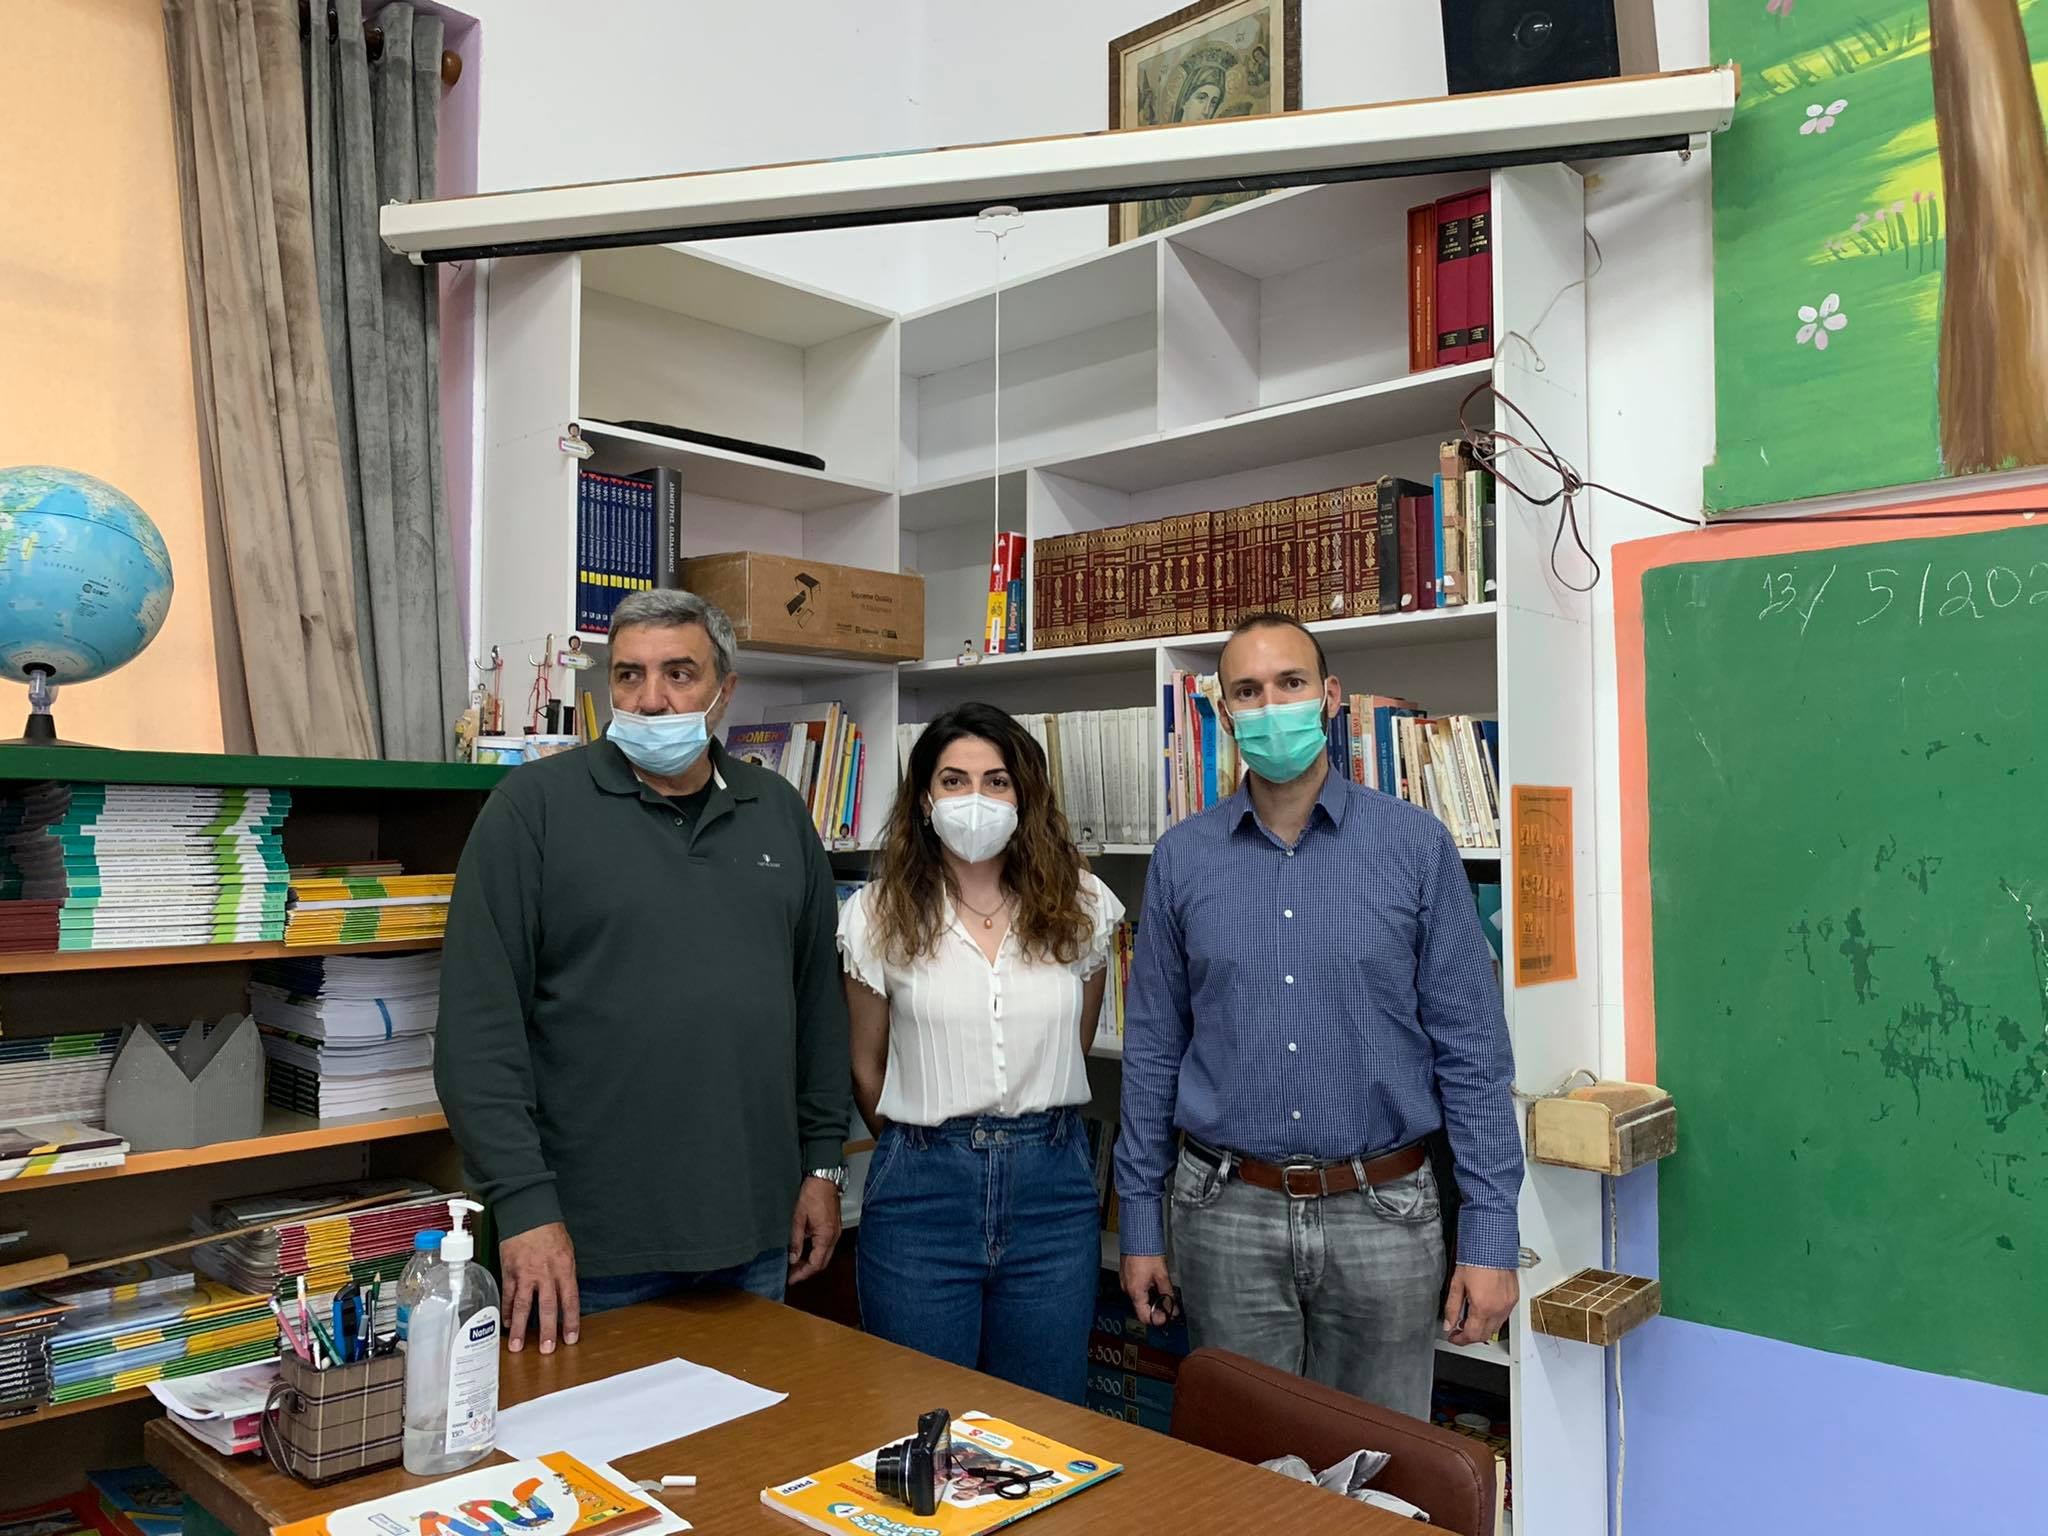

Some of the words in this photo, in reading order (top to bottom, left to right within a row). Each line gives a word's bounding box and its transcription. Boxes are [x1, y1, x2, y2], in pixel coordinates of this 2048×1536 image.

[1097, 1315, 1122, 1336] 500
[1095, 1345, 1122, 1366] 500
[1095, 1375, 1121, 1397] 500
[781, 1480, 813, 1495] PROF
